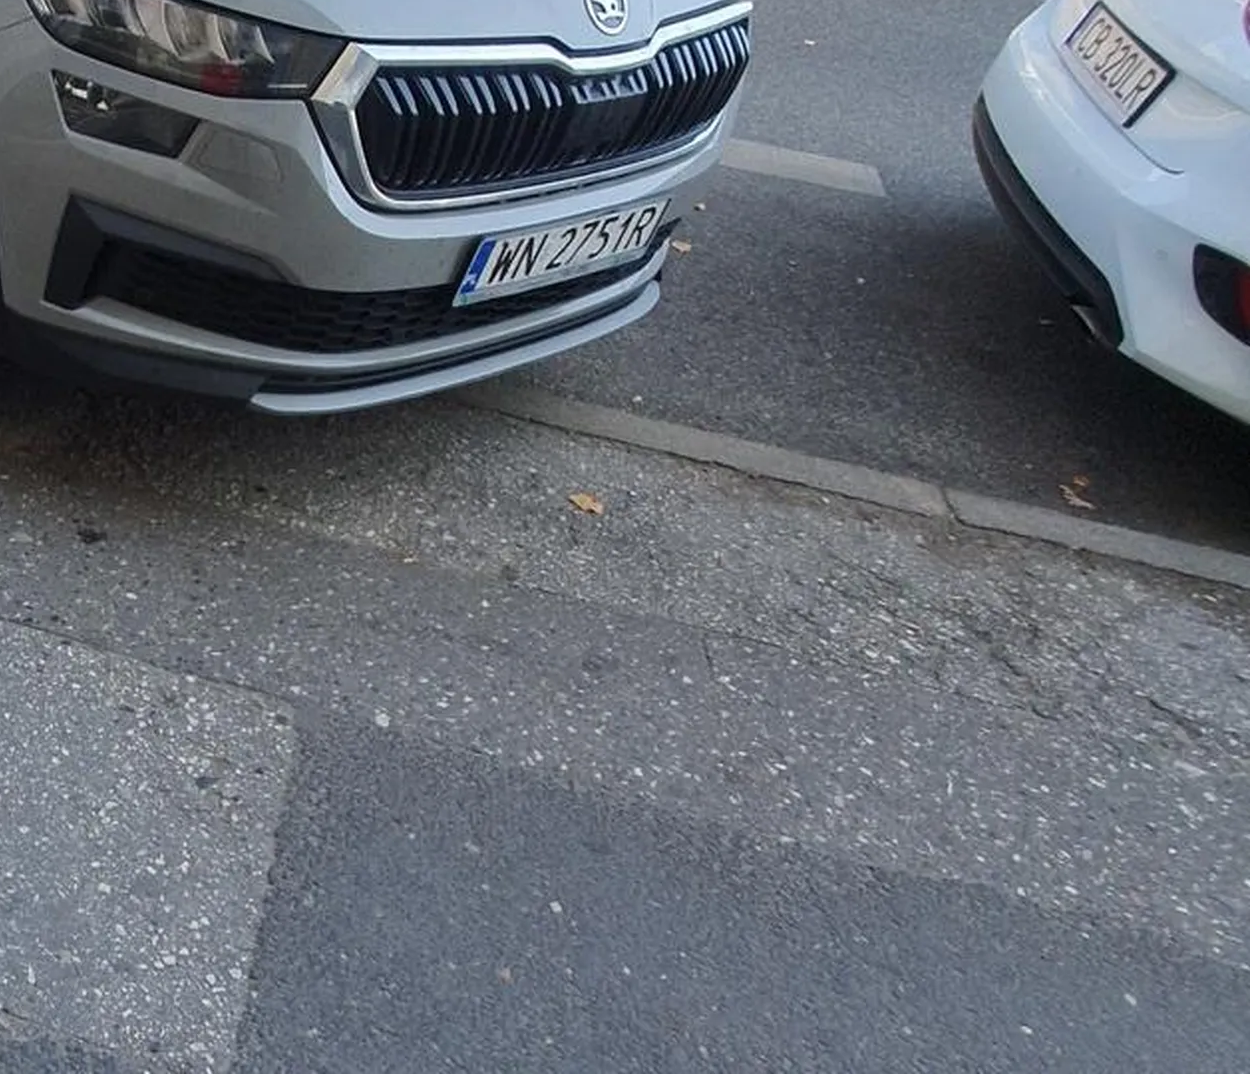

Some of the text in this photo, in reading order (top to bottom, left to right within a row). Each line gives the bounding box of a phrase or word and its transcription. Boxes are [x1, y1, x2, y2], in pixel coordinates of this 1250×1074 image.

[1078, 17, 1157, 111] CB 320LR
[488, 206, 657, 284] WN 2751R
